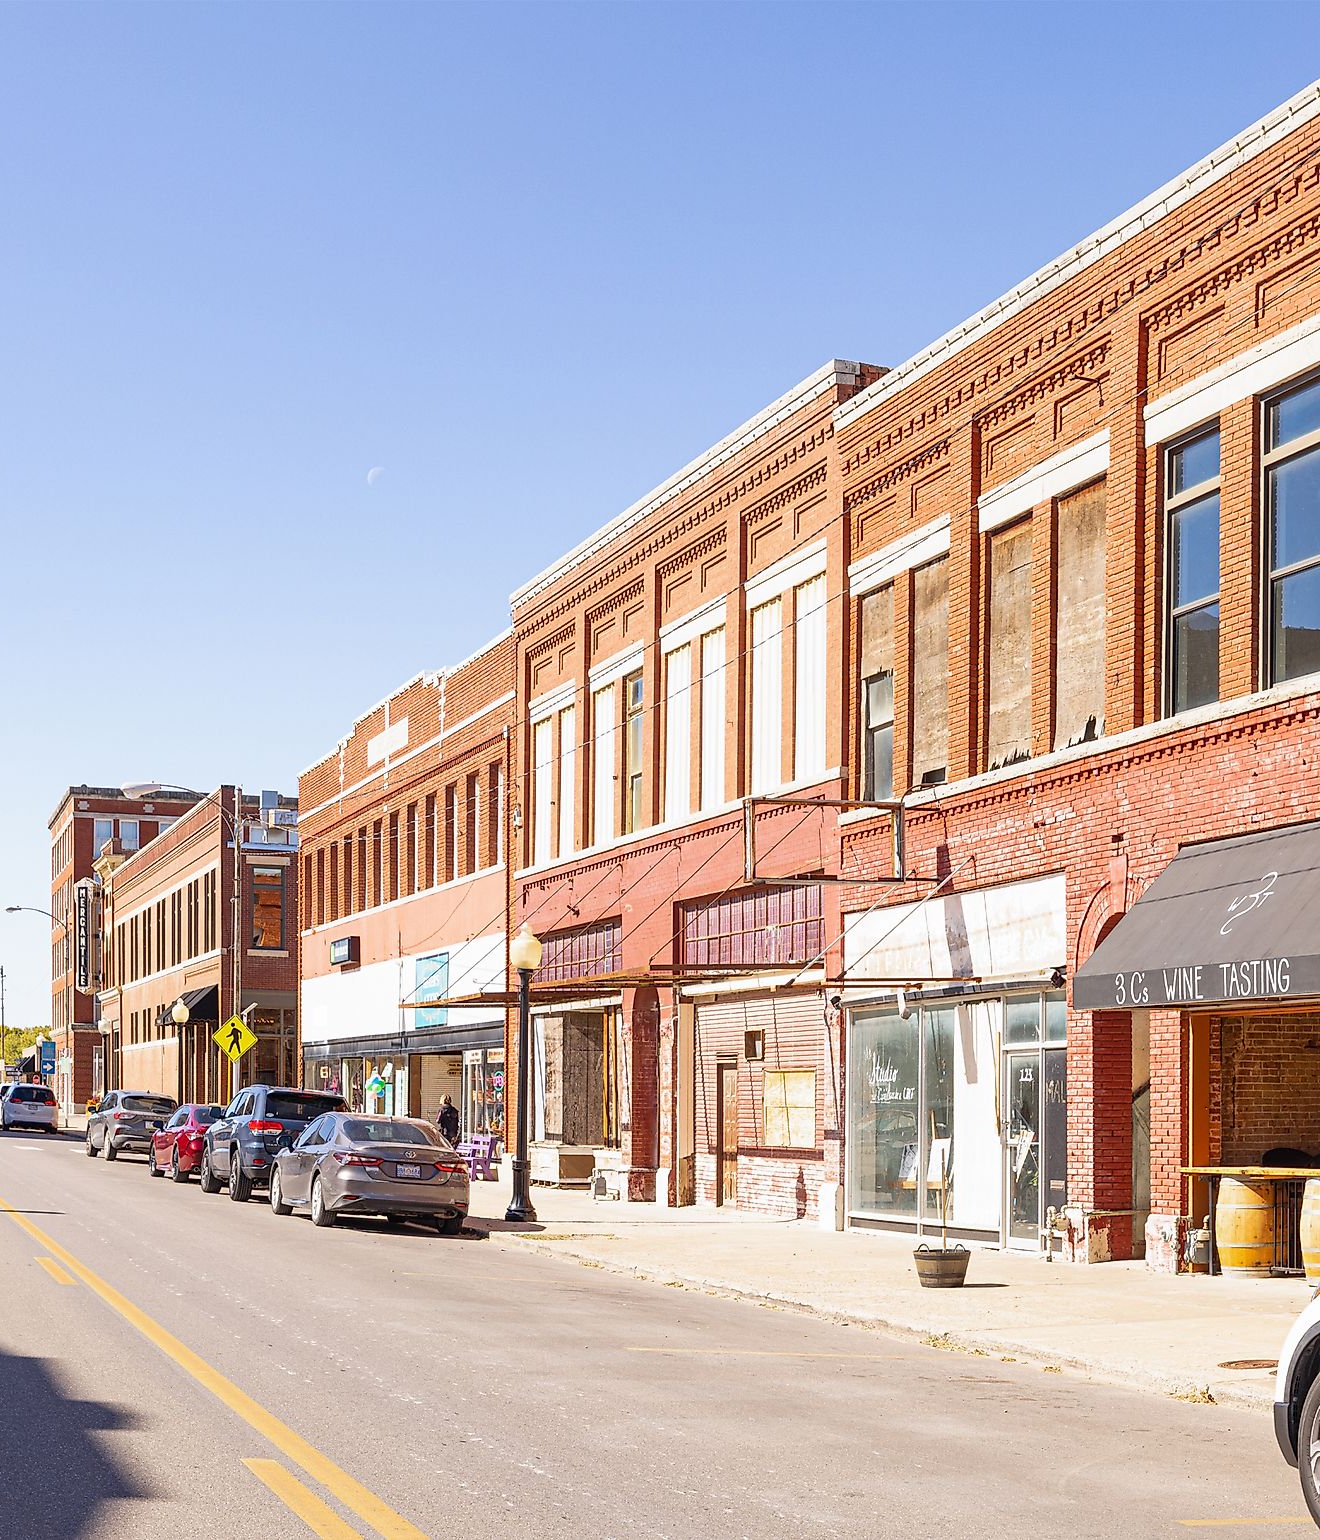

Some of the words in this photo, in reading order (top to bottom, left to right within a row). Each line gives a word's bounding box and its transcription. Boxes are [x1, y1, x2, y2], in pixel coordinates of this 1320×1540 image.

[1115, 972, 1126, 1005] 3
[1162, 965, 1204, 1001] WINE
[1219, 957, 1290, 997] TASTING
